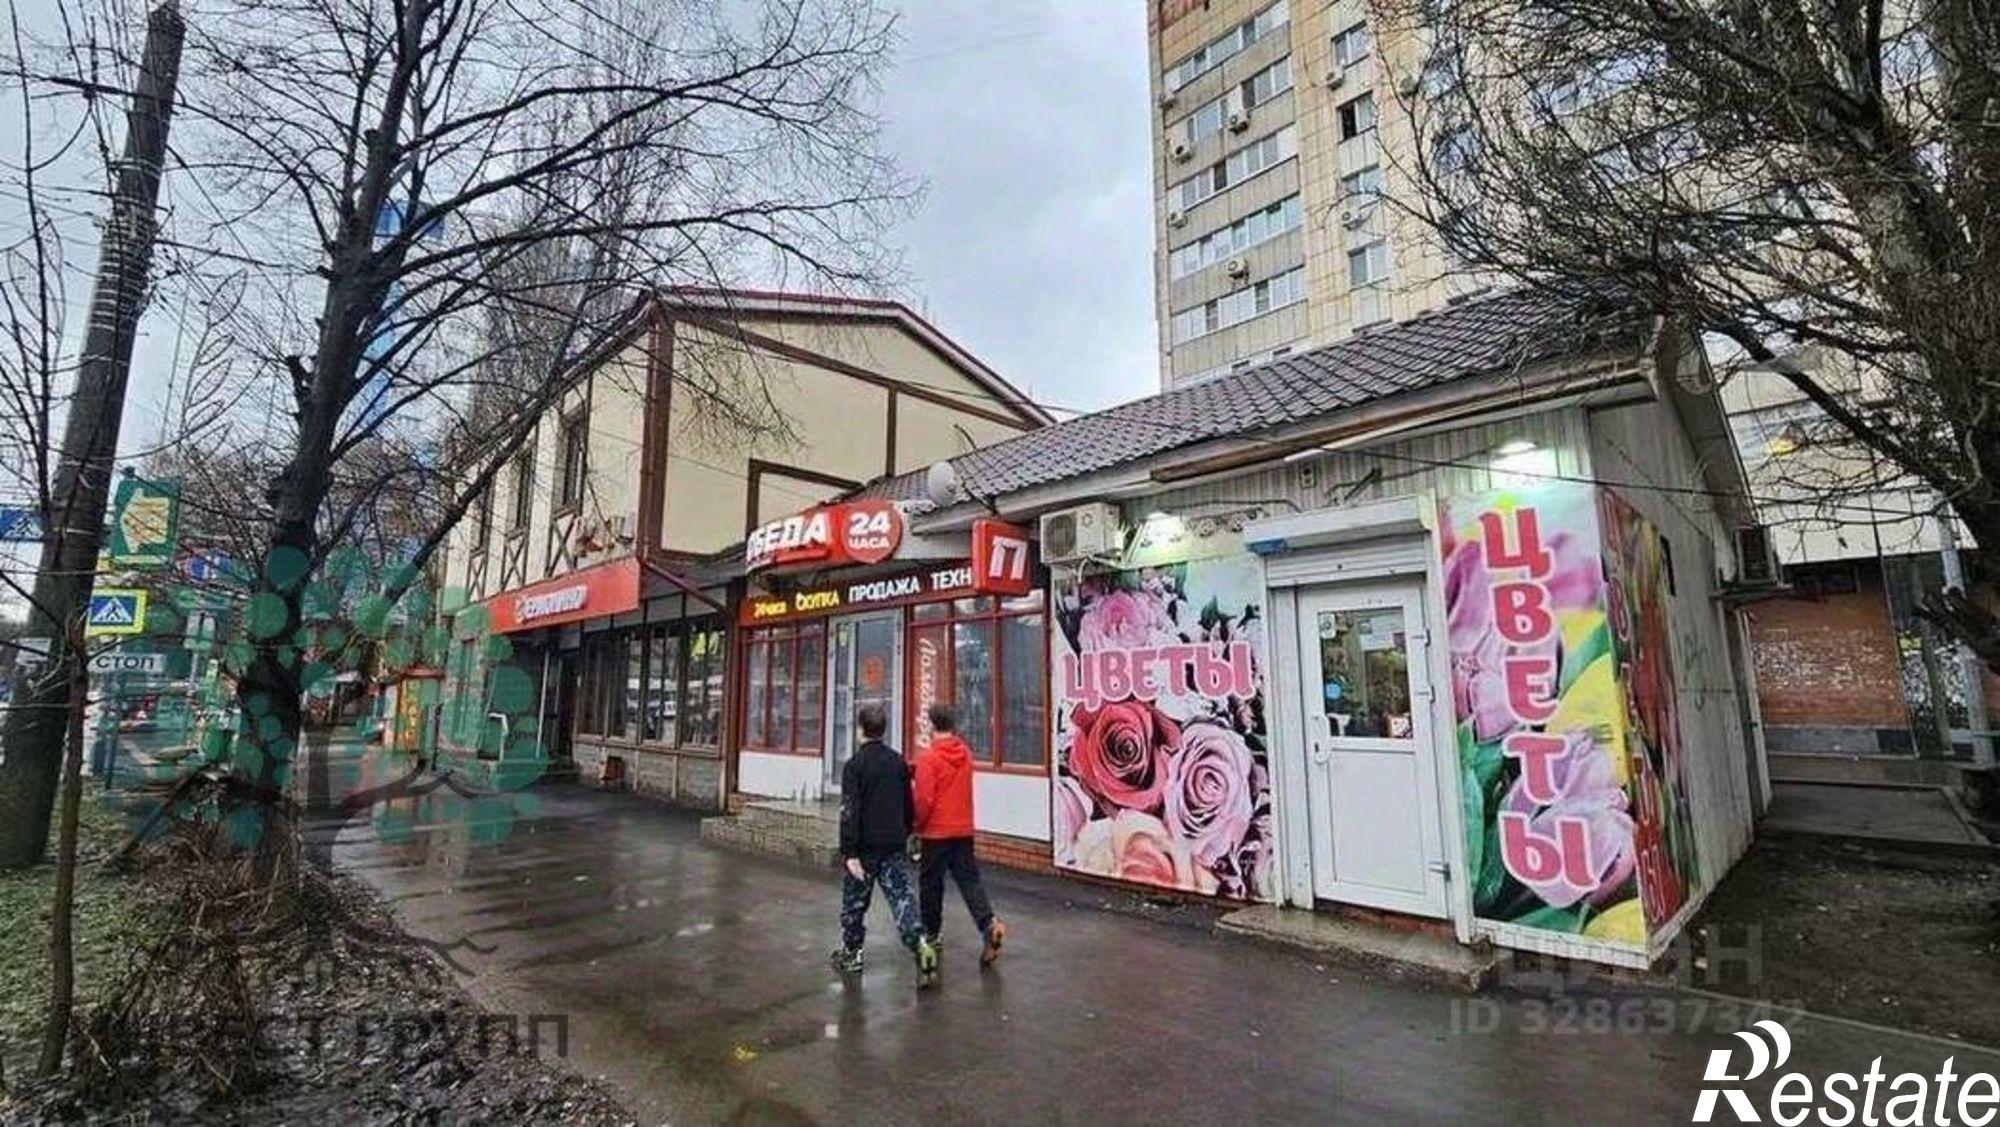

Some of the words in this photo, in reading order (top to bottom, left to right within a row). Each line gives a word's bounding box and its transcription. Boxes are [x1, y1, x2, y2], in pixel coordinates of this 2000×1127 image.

[849, 511, 891, 535] 24
[848, 536, 890, 549] ЧАСА
[988, 535, 1028, 580] П
[849, 575, 920, 602] ПРОДАЖА
[931, 566, 972, 590] ТЕХН
[95, 655, 154, 669] СТОП
[1062, 641, 1256, 710] ЦВЕТЫ
[1480, 506, 1599, 890] ЦВЕТЫ
